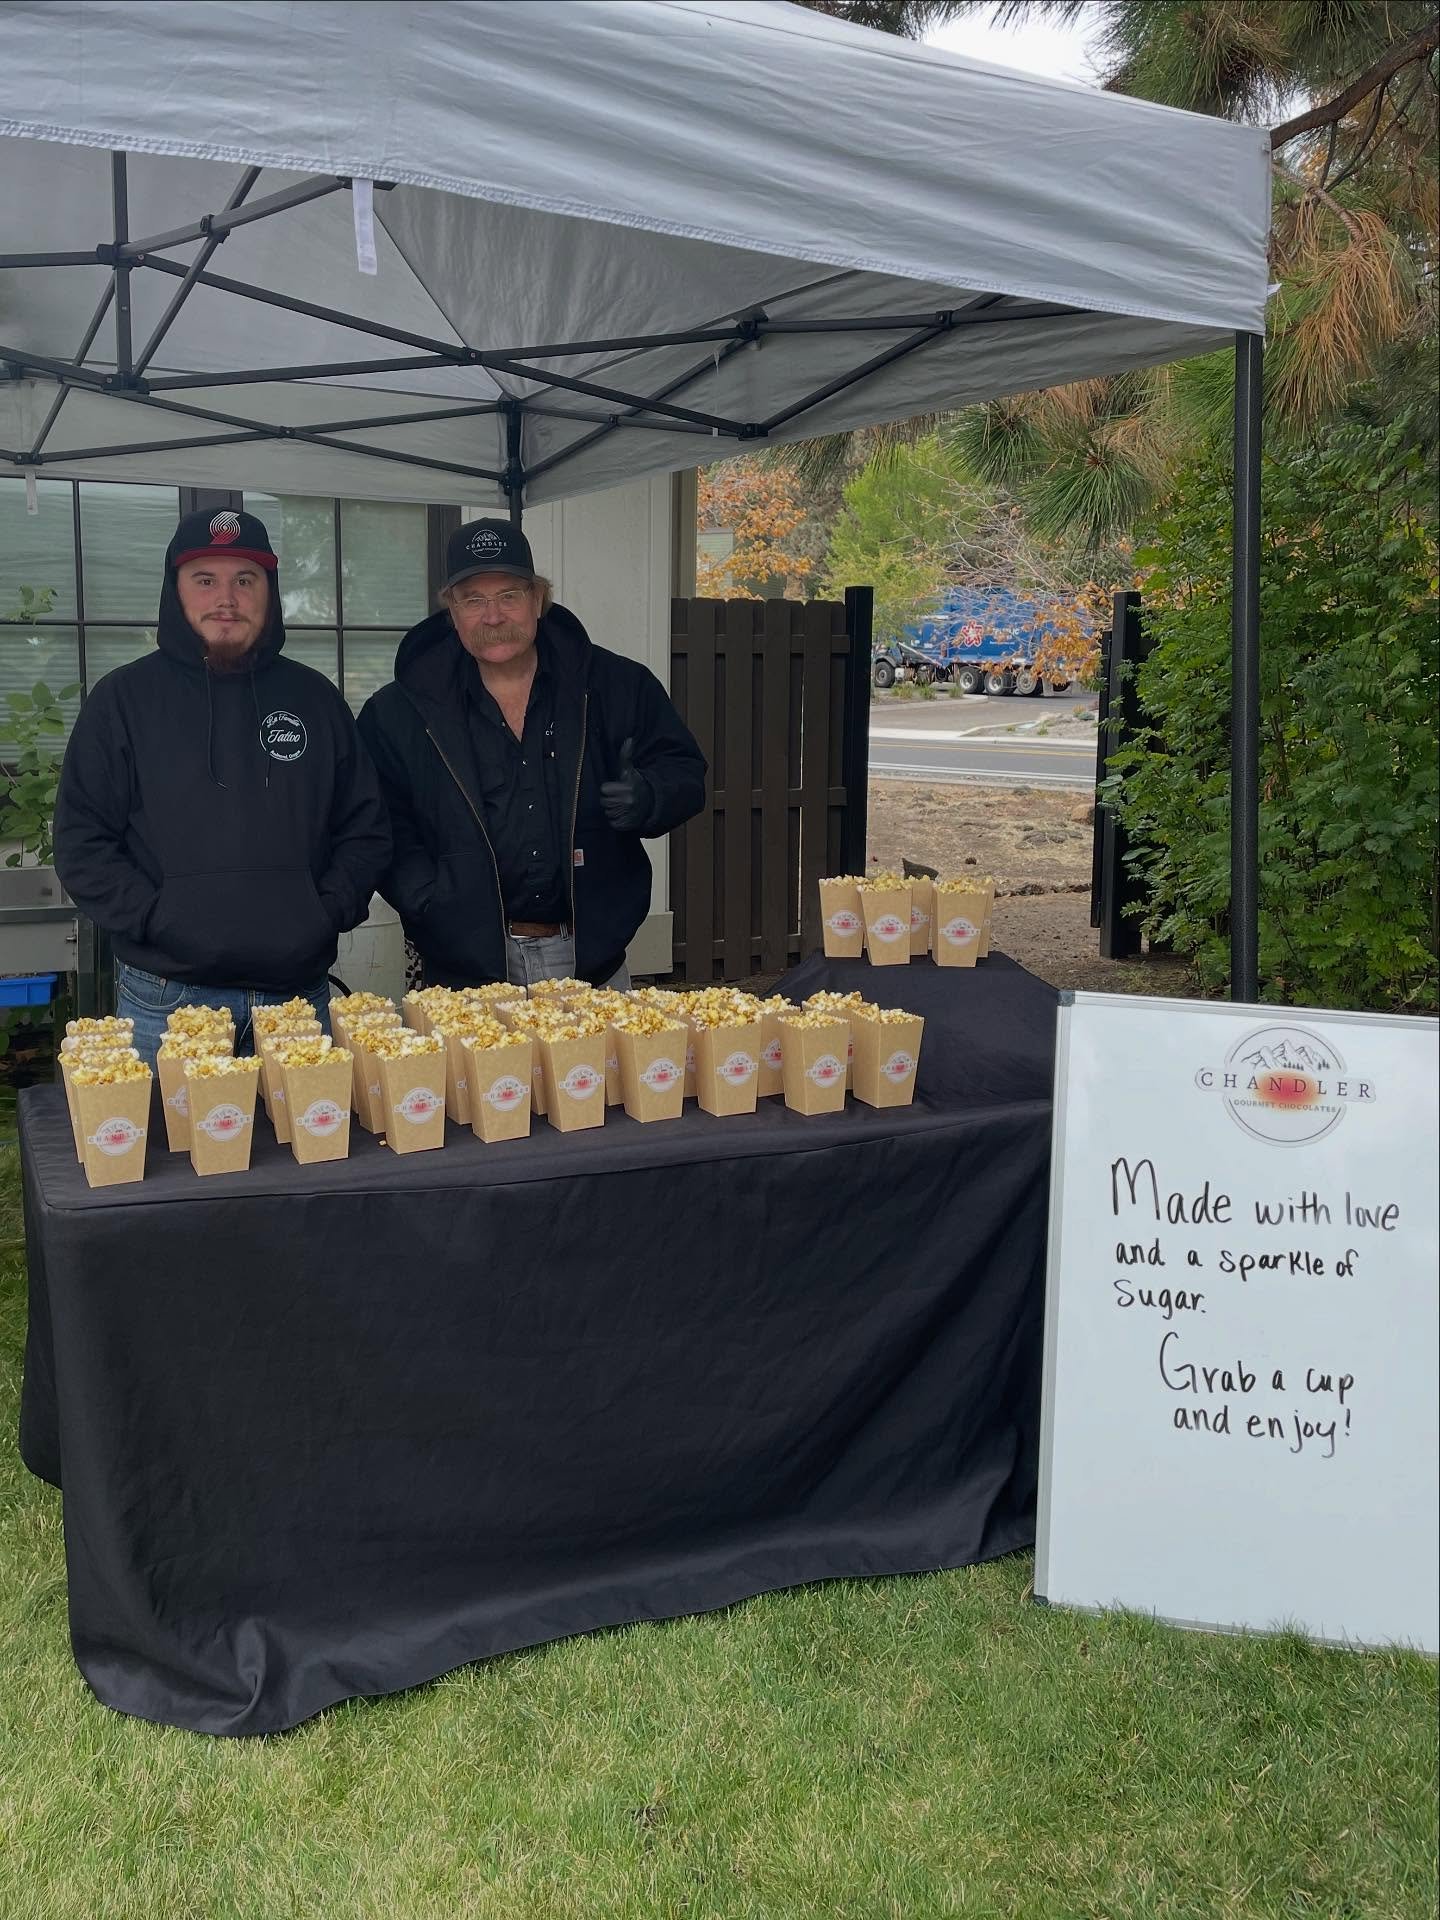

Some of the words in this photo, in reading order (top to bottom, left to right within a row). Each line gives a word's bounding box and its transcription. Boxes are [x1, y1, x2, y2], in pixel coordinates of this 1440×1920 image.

[267, 729, 301, 744] Tattoo
[1201, 1072, 1371, 1098] CHANDLER
[1233, 1099, 1275, 1109] GOURMET
[1279, 1103, 1337, 1113] CHOCOLATES
[1111, 1157, 1232, 1225] Made
[1255, 1191, 1332, 1225] with
[1345, 1191, 1400, 1231] love
[1116, 1237, 1166, 1266] and
[1187, 1249, 1203, 1267] a
[1335, 1248, 1359, 1277] of
[1159, 1331, 1257, 1394] Grab
[1272, 1369, 1286, 1391] a
[1306, 1368, 1355, 1405] cup
[1173, 1404, 1231, 1435] and
